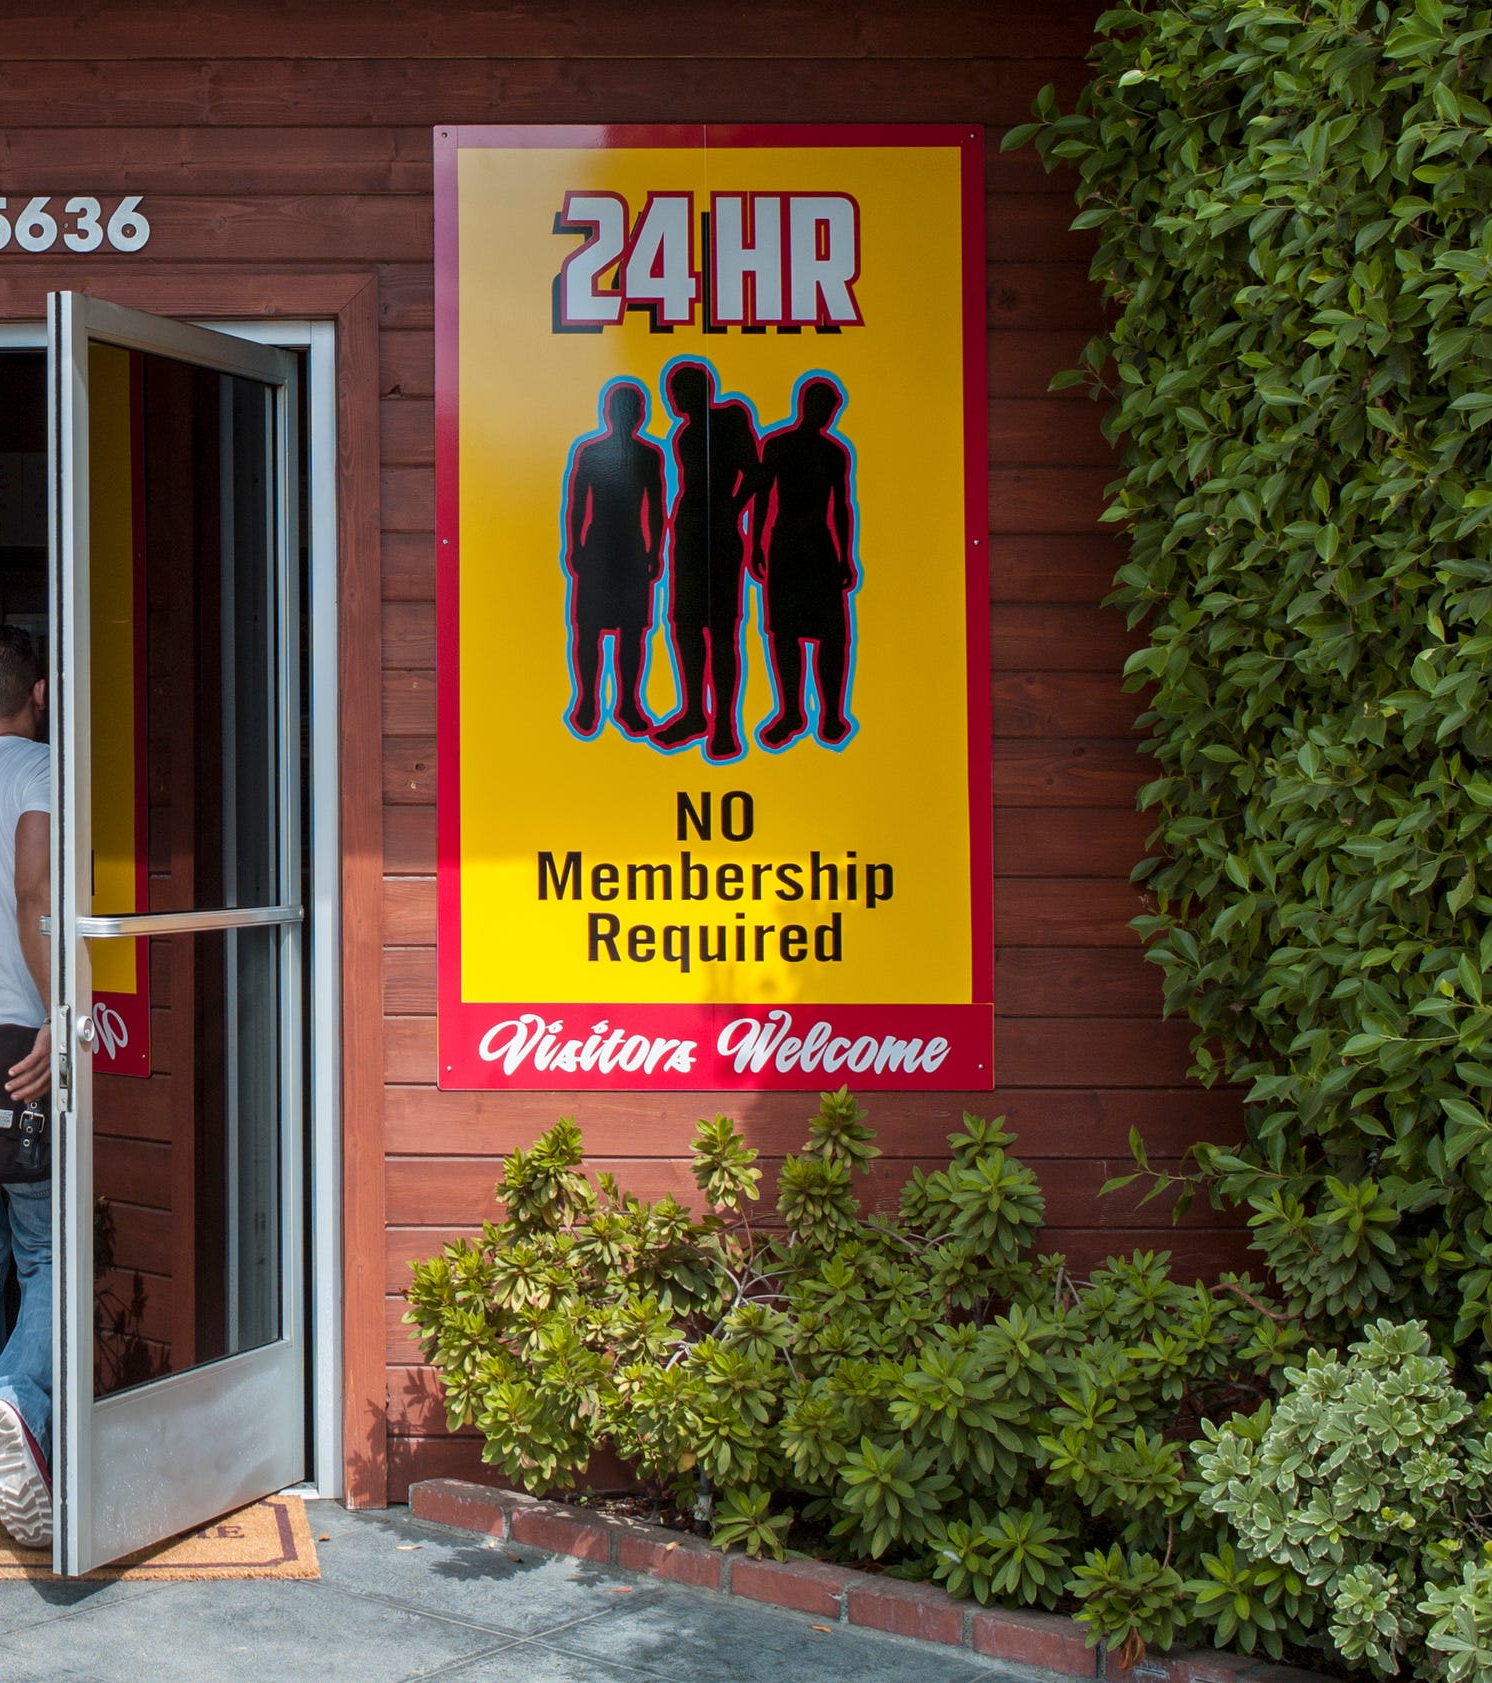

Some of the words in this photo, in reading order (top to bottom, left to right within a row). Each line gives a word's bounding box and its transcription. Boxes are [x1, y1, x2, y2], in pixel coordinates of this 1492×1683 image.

[557, 190, 866, 331] 24HR
[676, 790, 754, 842] NO
[537, 850, 895, 909] Membership
[587, 912, 843, 973] Required
[478, 1013, 698, 1076] Visitors
[716, 1009, 952, 1075] Welcome
